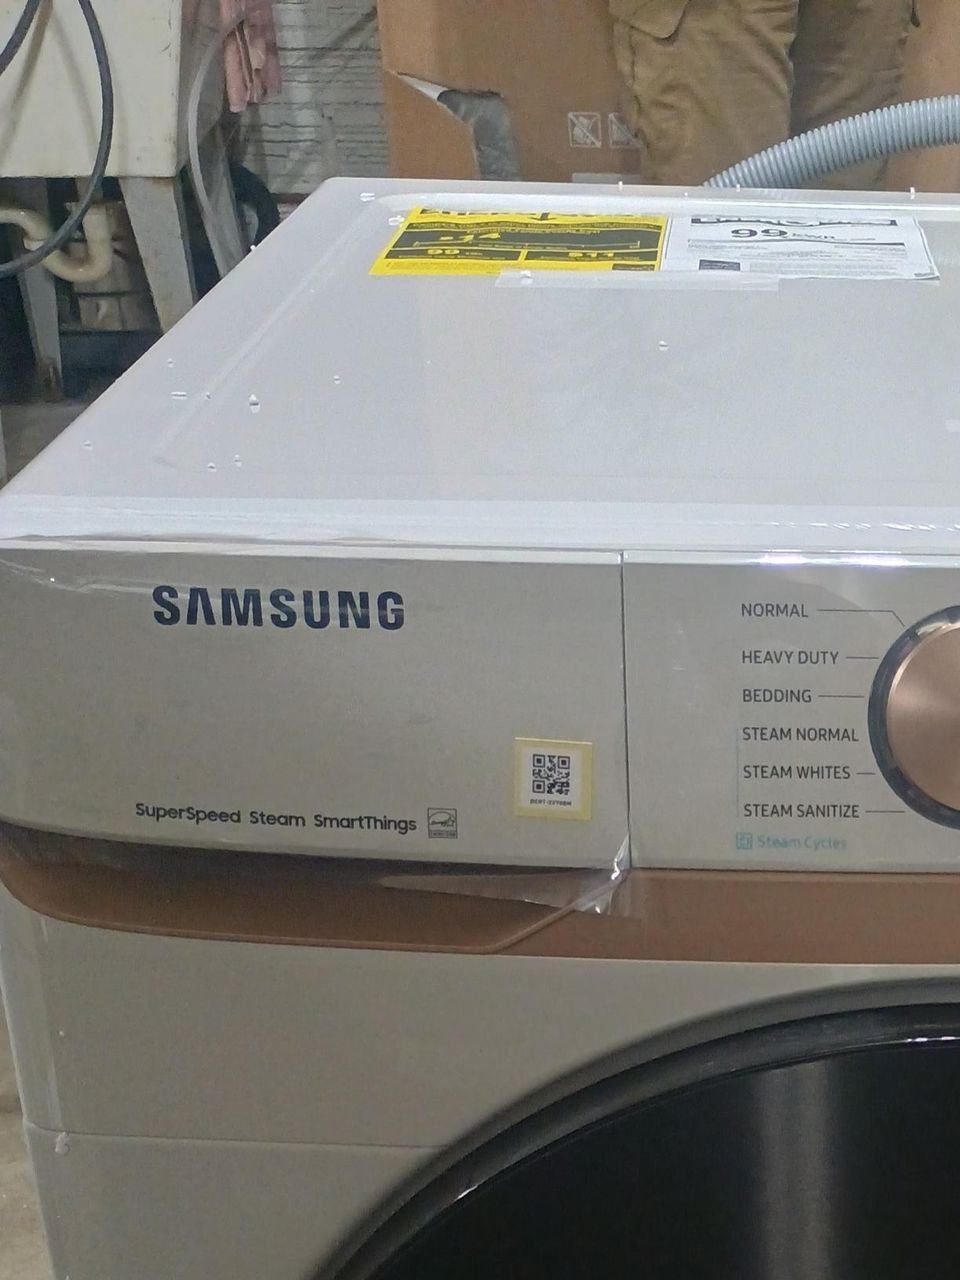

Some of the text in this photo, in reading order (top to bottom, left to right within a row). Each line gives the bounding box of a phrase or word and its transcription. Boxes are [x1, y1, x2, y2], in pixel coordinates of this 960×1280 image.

[730, 228, 789, 239] 99
[153, 586, 406, 630] SAMSUNG
[740, 603, 809, 618] NORMAL
[742, 651, 839, 665] HEAVY DUTY
[742, 689, 812, 703] BEDDING
[742, 728, 859, 743] STEAM NORMAL
[743, 766, 851, 781] STEAM WHITES
[135, 802, 418, 835] SuperSpeed Steam SmartThings
[743, 804, 860, 819] STEAM SANITIZE
[757, 834, 848, 852] Steam Cycles
